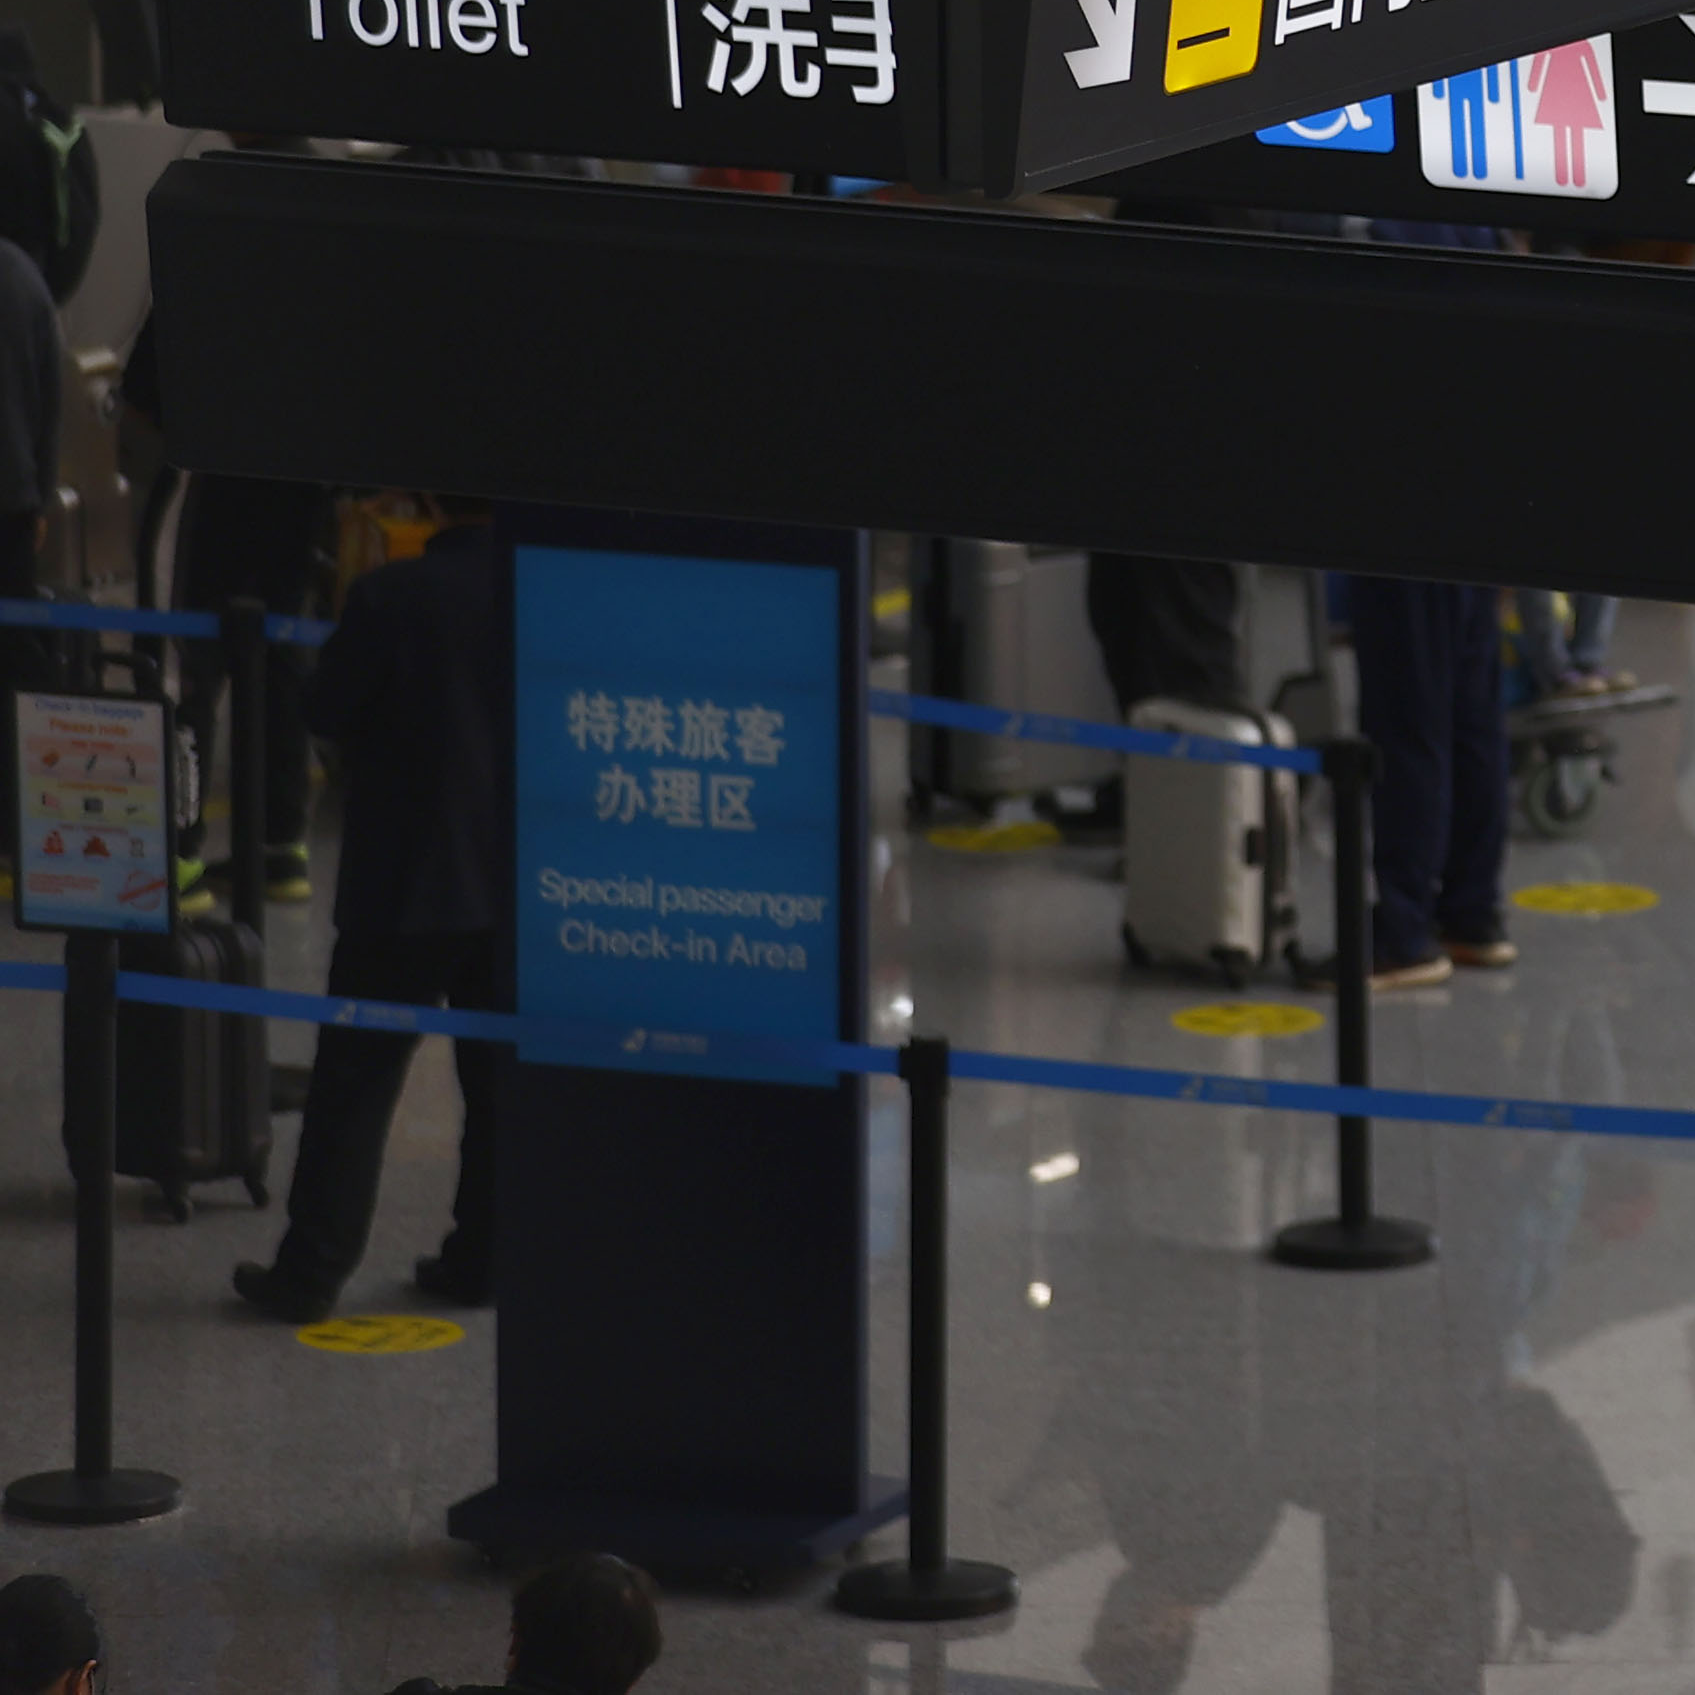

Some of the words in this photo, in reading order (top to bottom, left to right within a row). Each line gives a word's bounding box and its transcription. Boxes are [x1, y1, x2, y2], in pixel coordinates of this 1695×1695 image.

[566, 690, 786, 767] 特殊旅客
[595, 762, 756, 831] 办理区
[539, 867, 654, 909] Special
[658, 883, 826, 928] passenger
[558, 917, 718, 963] Check-in
[725, 929, 808, 972] Area
